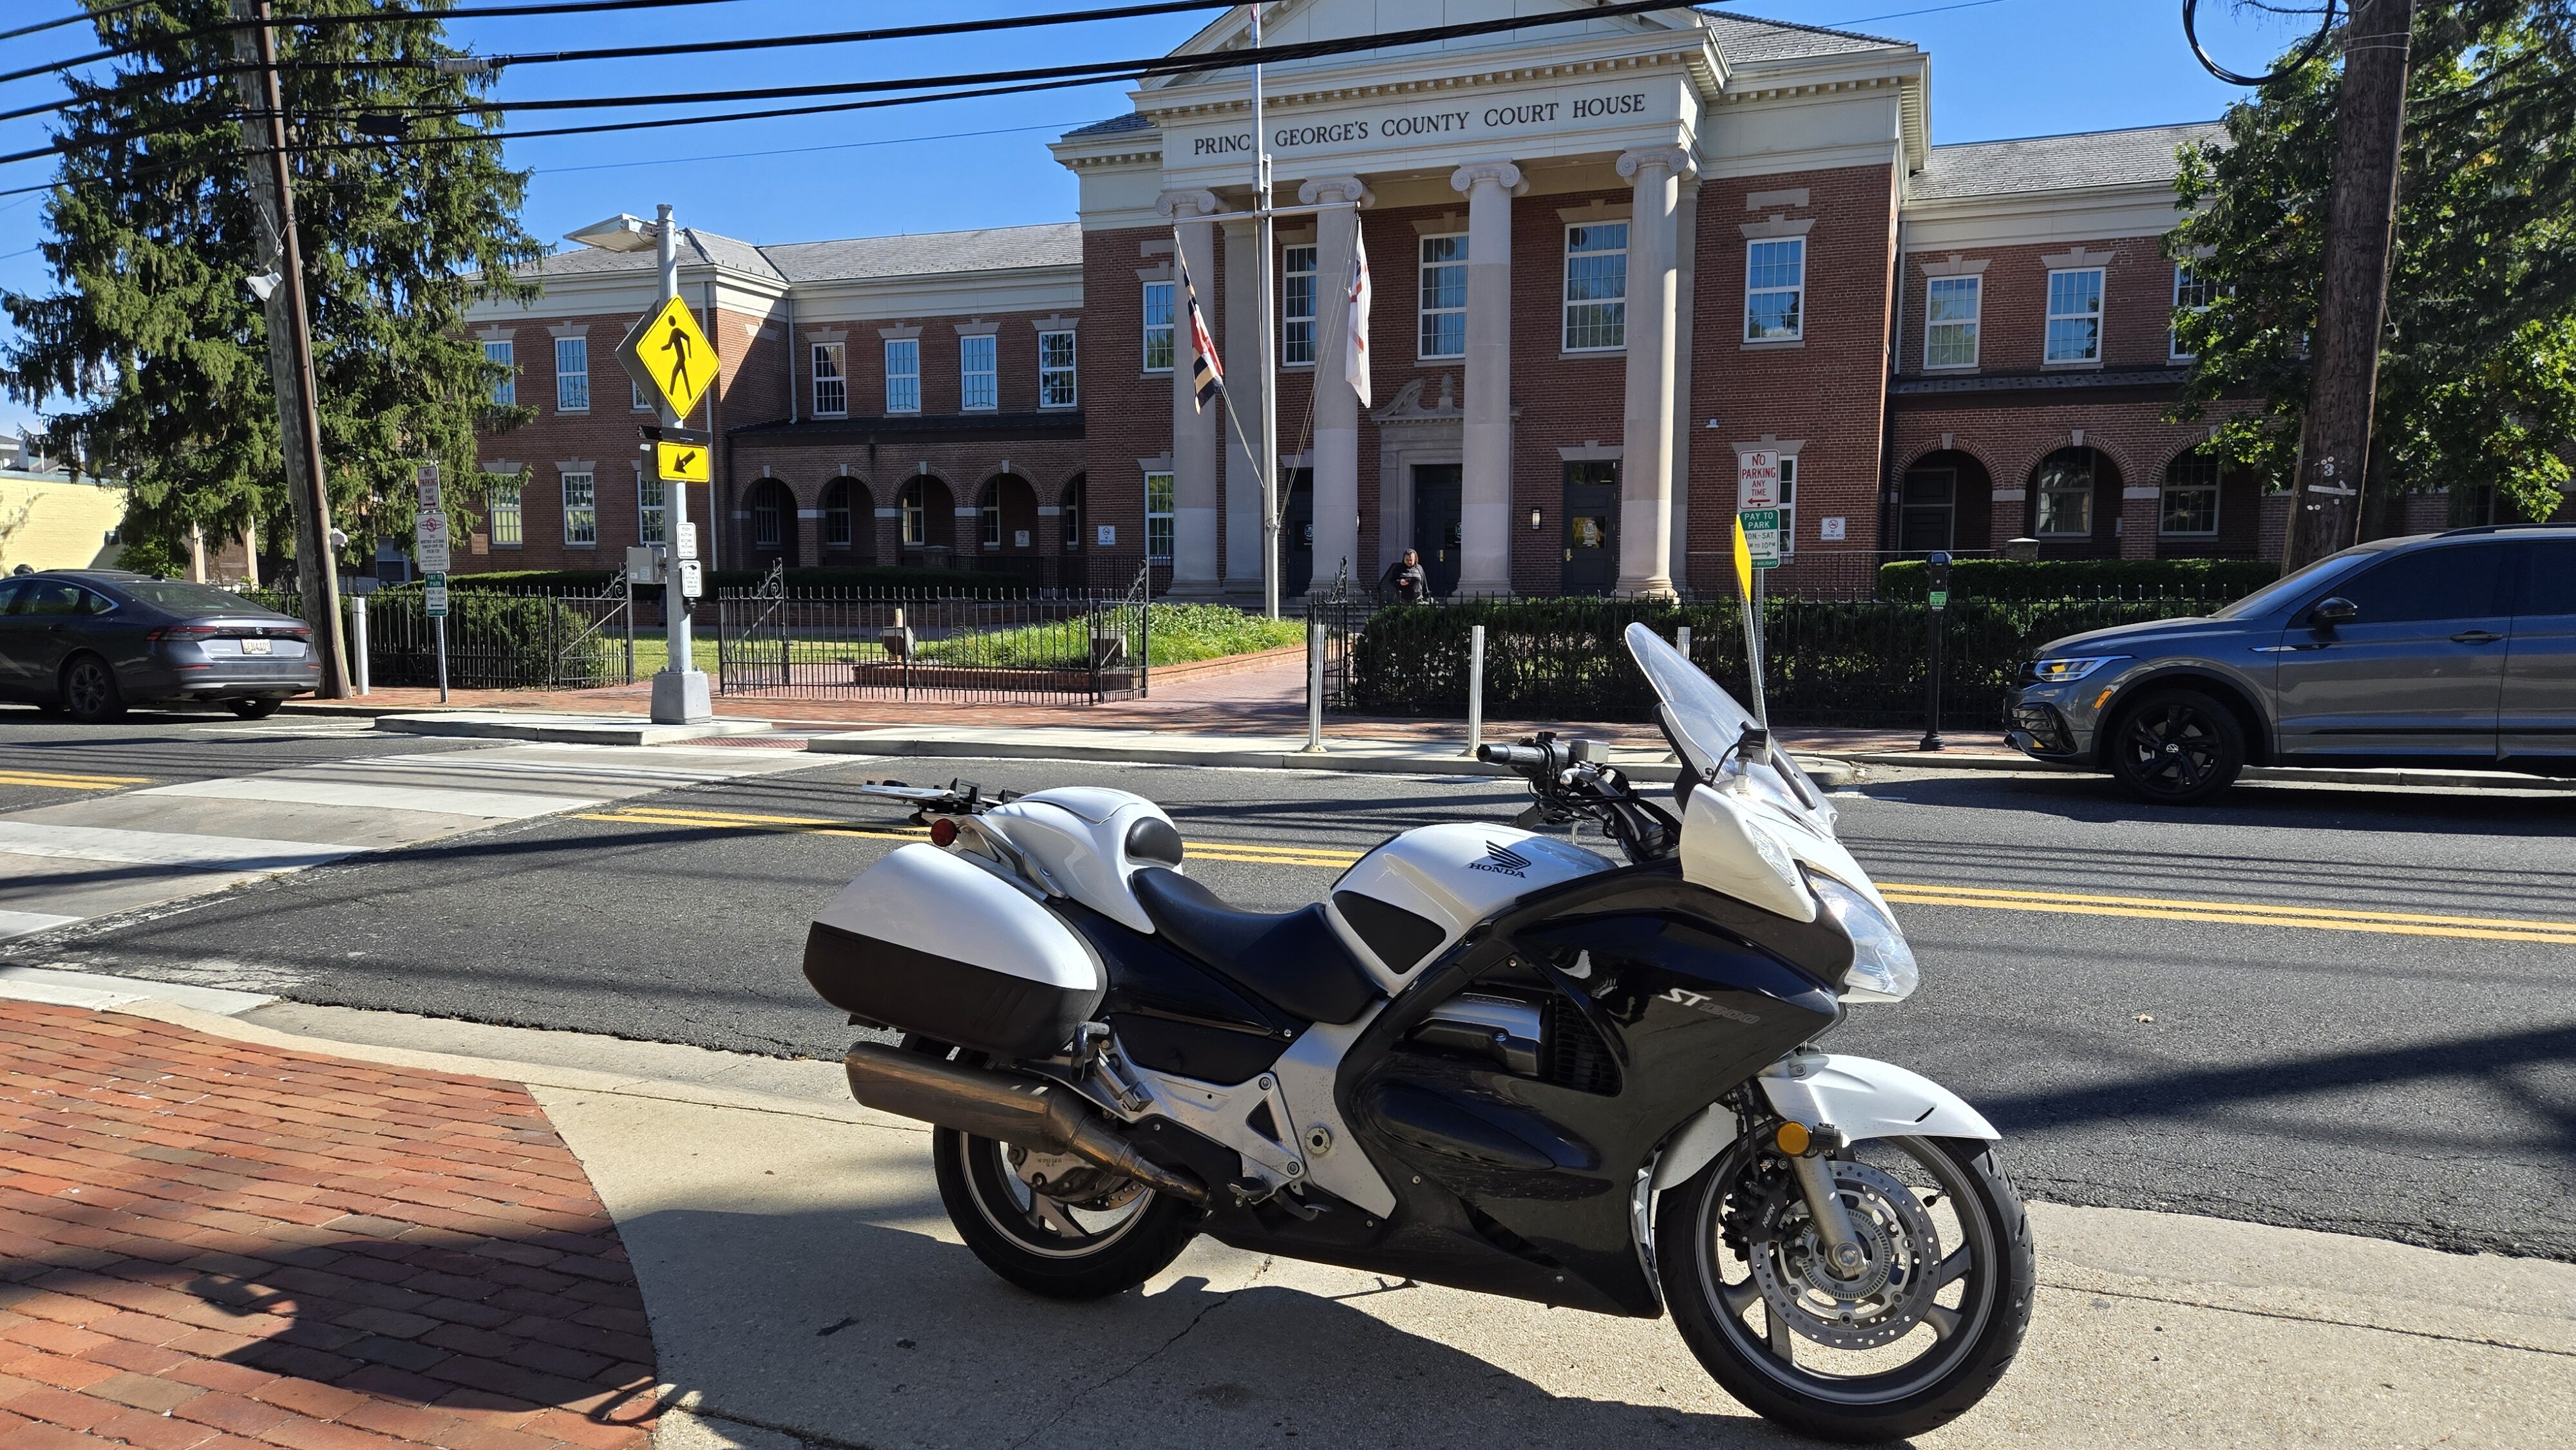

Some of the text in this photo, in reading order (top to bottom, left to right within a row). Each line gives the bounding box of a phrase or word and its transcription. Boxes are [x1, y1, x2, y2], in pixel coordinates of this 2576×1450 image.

[1195, 94, 1645, 155] PRINC GEORGE'S COUNTY COURT HOUSE
[1752, 455, 1765, 466] NO
[424, 469, 431, 477] NO
[1742, 467, 1776, 479] PARKING
[420, 478, 437, 487] PARKING
[1748, 521, 1770, 529] PARK
[1468, 863, 1526, 879] HONDA
